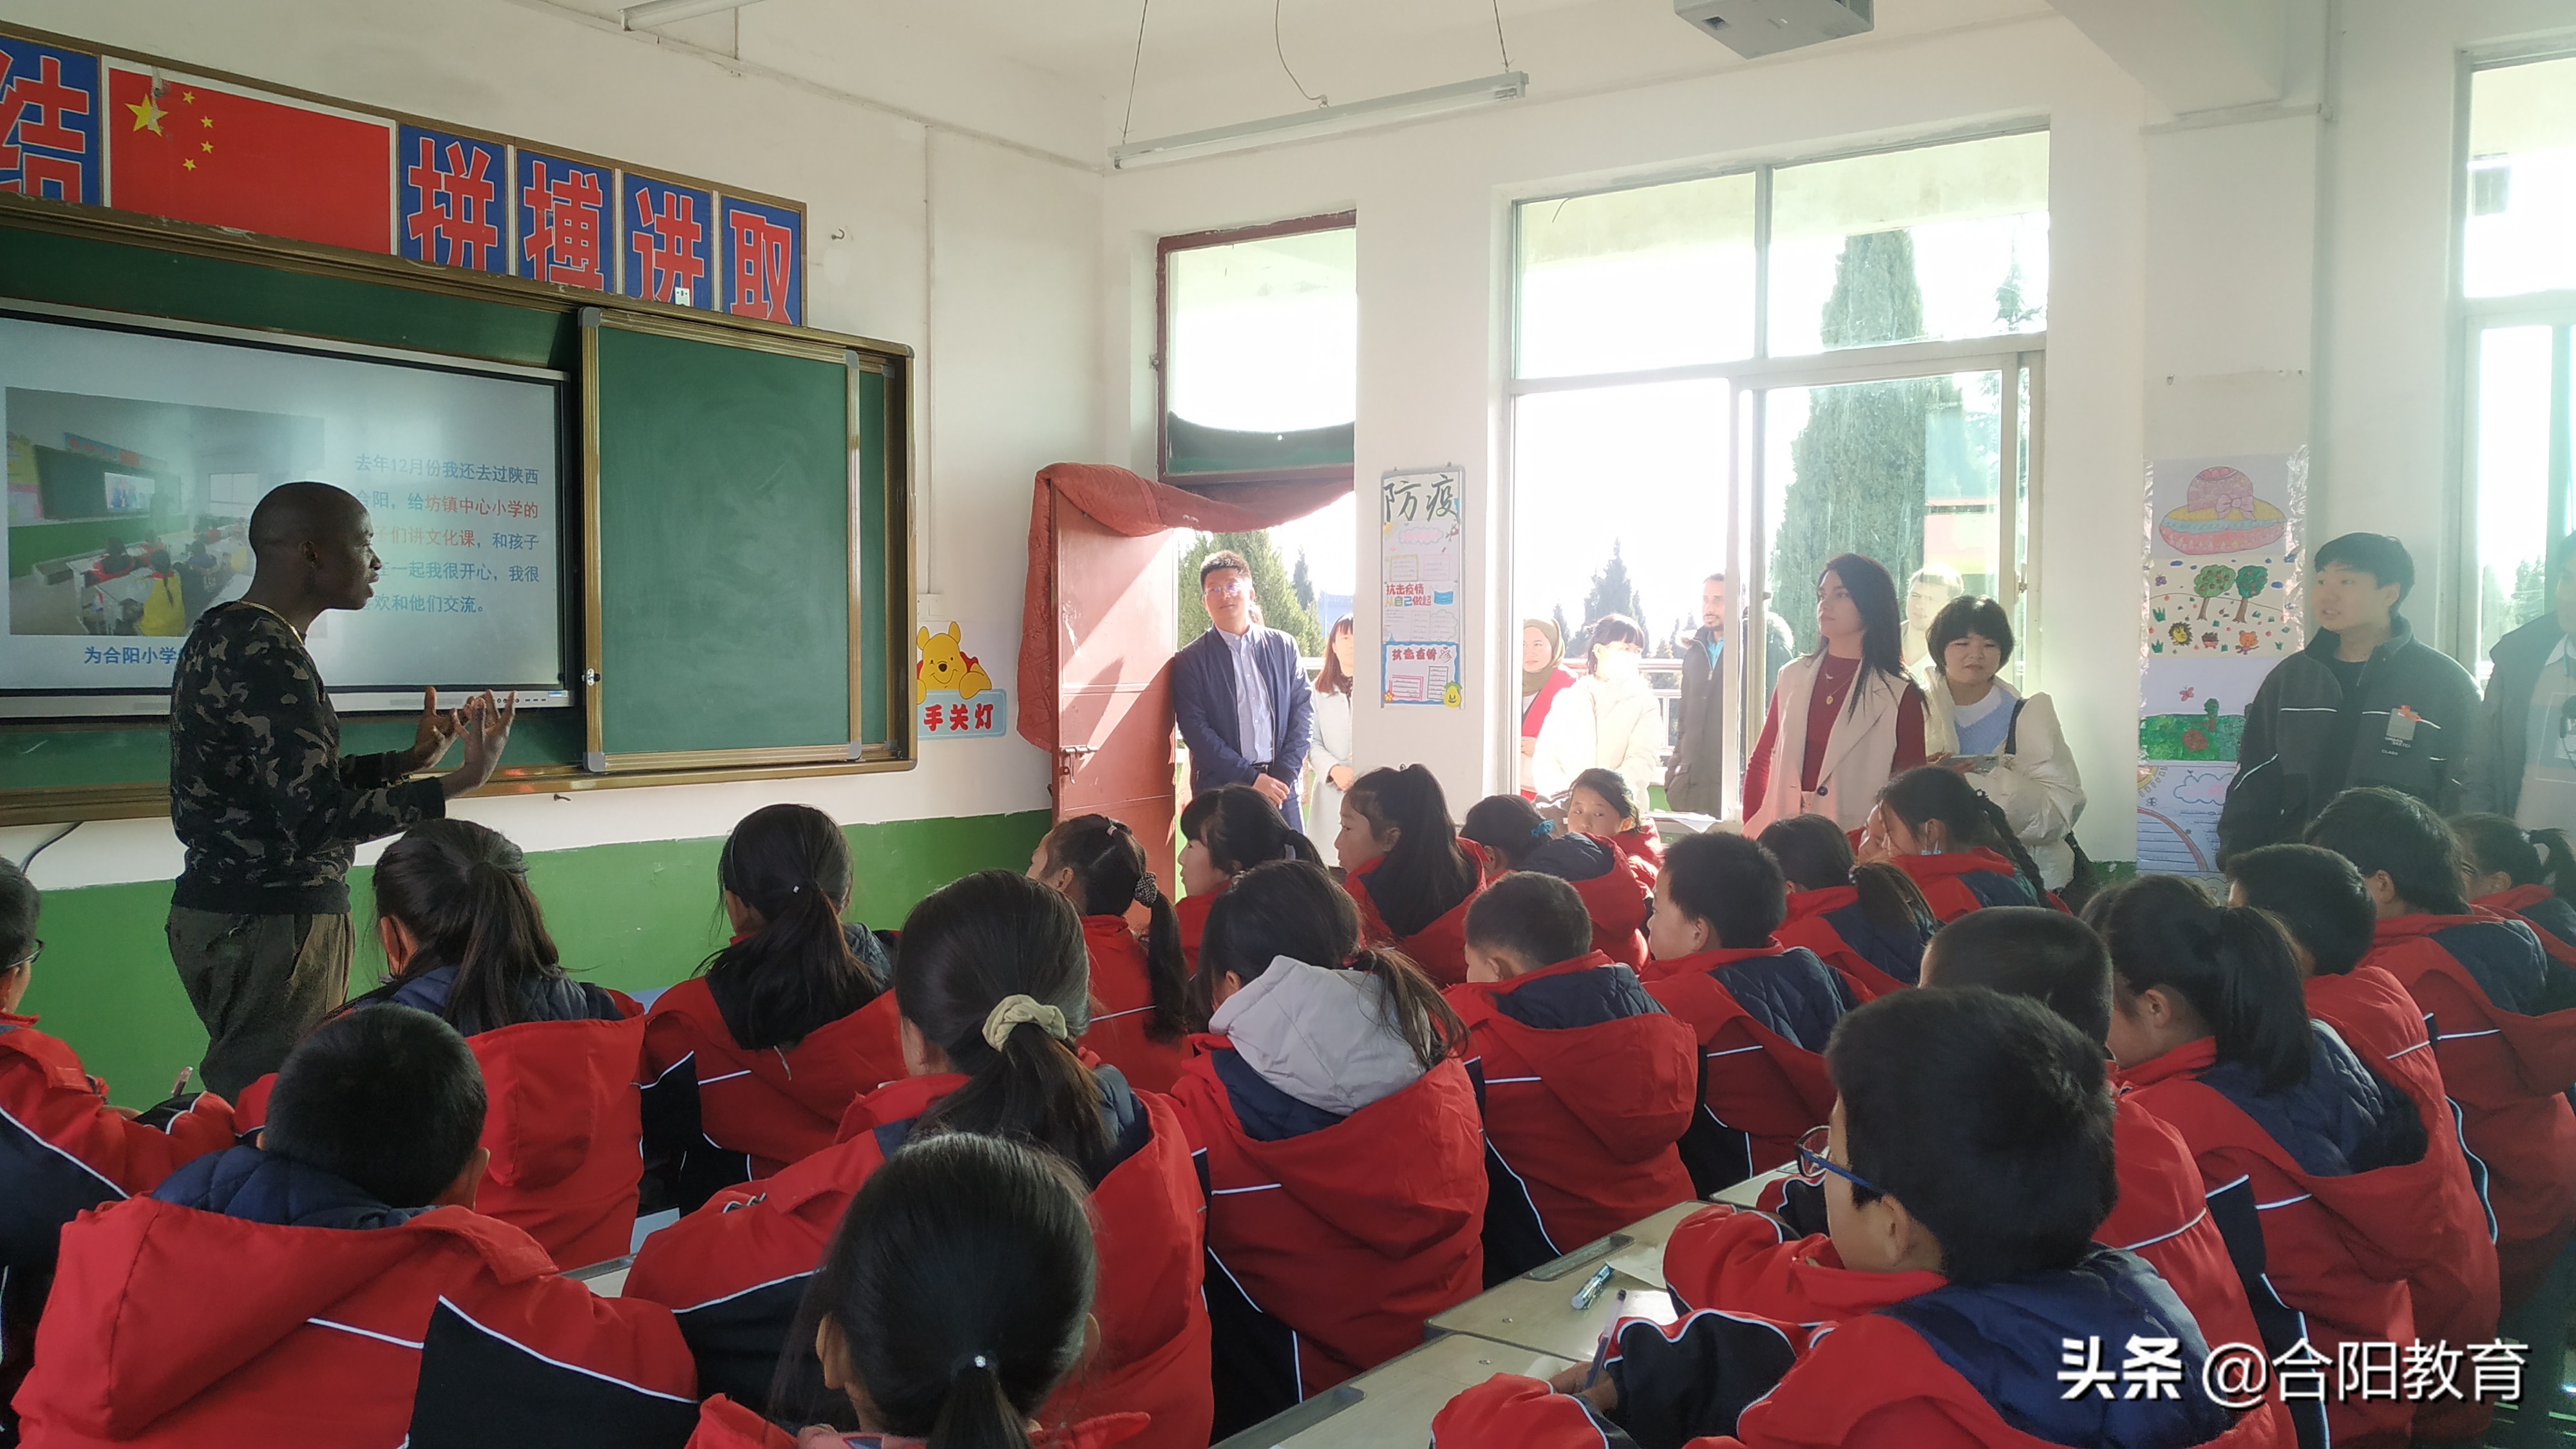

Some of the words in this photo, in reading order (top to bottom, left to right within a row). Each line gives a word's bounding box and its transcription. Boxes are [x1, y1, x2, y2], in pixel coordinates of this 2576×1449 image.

[407, 137, 794, 325] 拼搏进取
[354, 453, 539, 485] 去年12月份我还去过陕西
[1383, 473, 1461, 523] 防疫
[1385, 595, 1432, 607] 从自己做起
[1386, 583, 1425, 595] 抗击疫情
[84, 646, 183, 664] 为合阳小学
